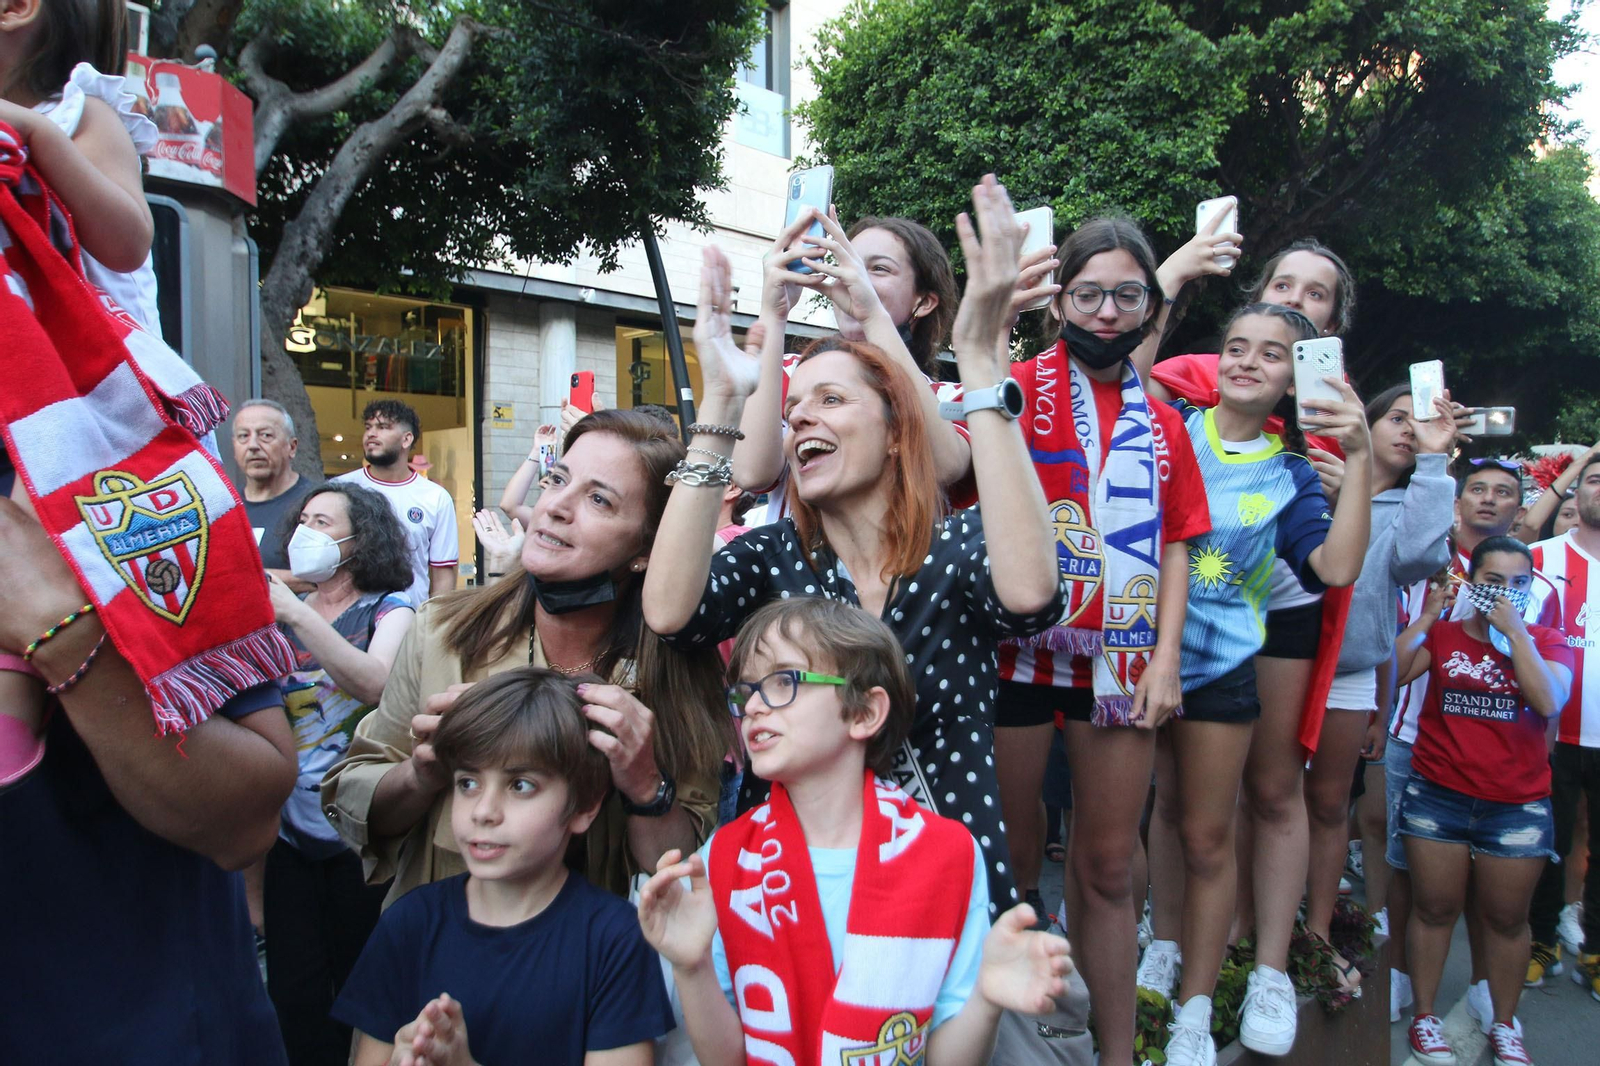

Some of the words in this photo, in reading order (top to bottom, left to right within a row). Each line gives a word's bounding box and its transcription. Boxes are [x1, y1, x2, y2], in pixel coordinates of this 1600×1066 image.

[90, 506, 113, 526] U
[147, 489, 180, 512] D
[112, 518, 195, 551] ALMERIA
[1443, 704, 1461, 713] FOR
[1462, 706, 1480, 716] THE
[1480, 708, 1514, 719] PLANET
[1444, 692, 1492, 708] STAND
[1494, 697, 1516, 710] UP
